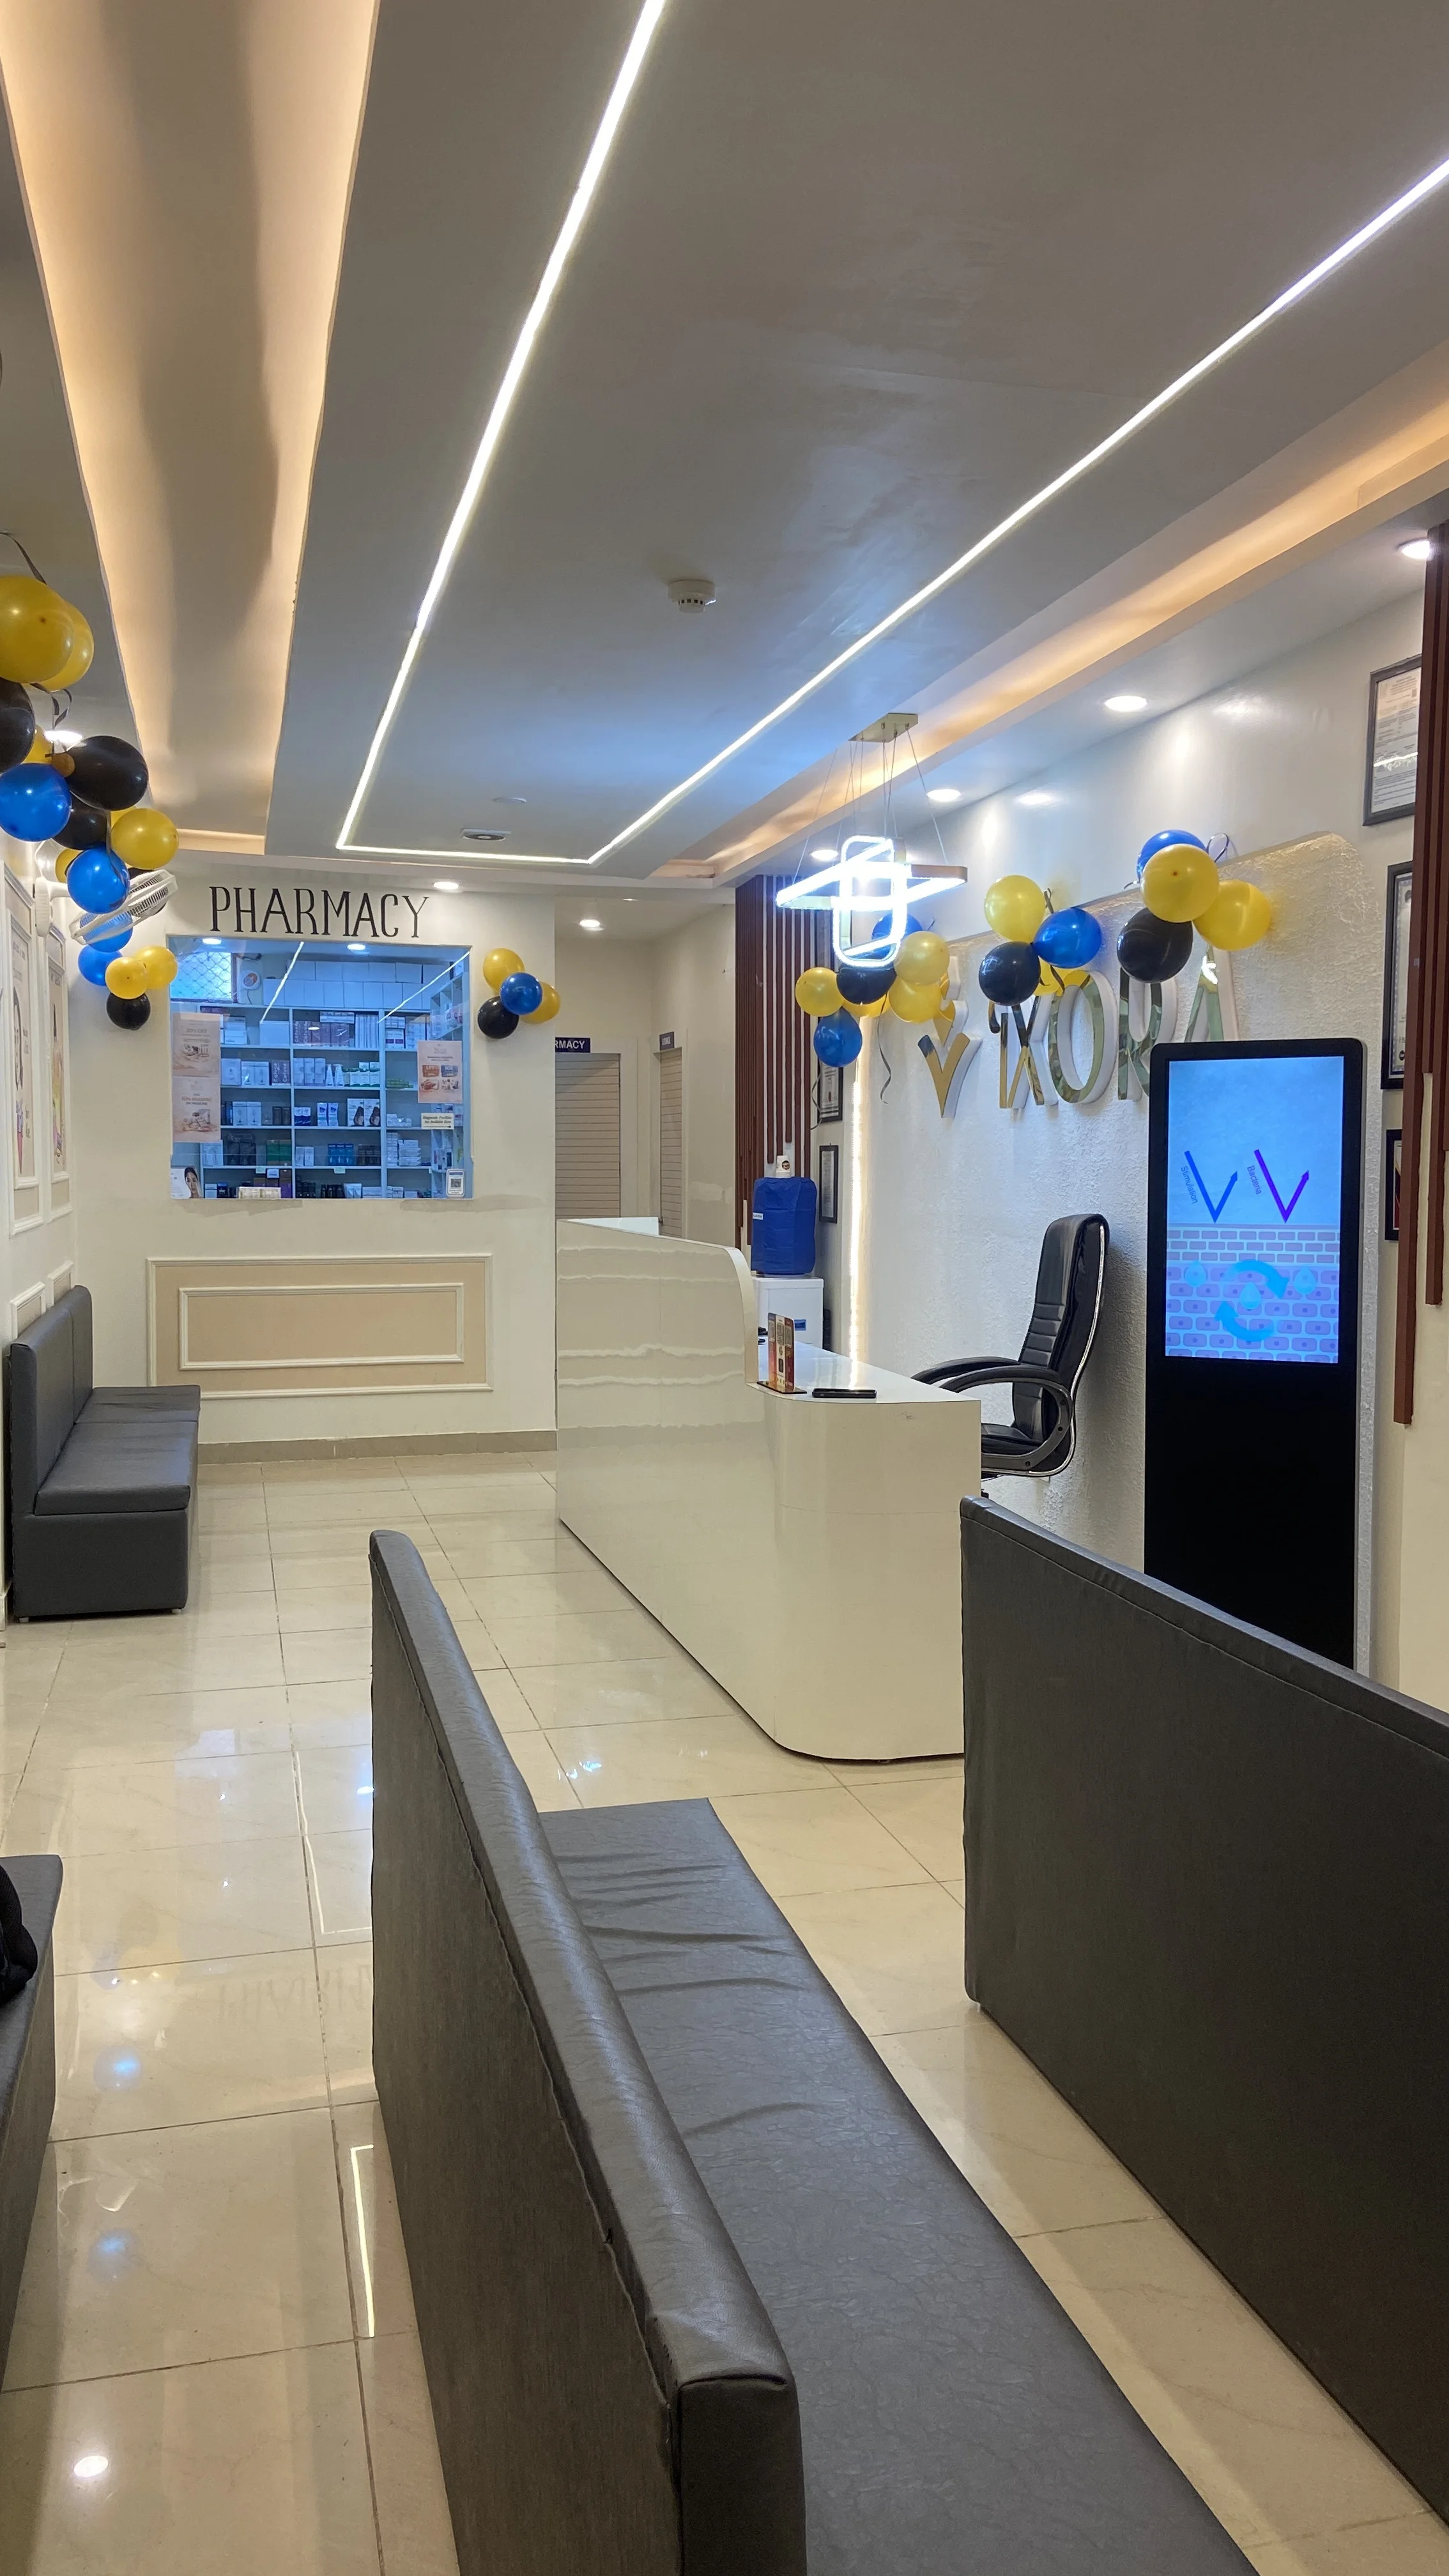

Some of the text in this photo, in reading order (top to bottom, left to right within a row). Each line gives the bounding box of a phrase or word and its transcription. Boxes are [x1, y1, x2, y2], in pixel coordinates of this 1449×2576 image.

[209, 886, 429, 938] PHARMACY
[1180, 1165, 1198, 1204] Stimulation
[1246, 1165, 1262, 1195] Bacteria
